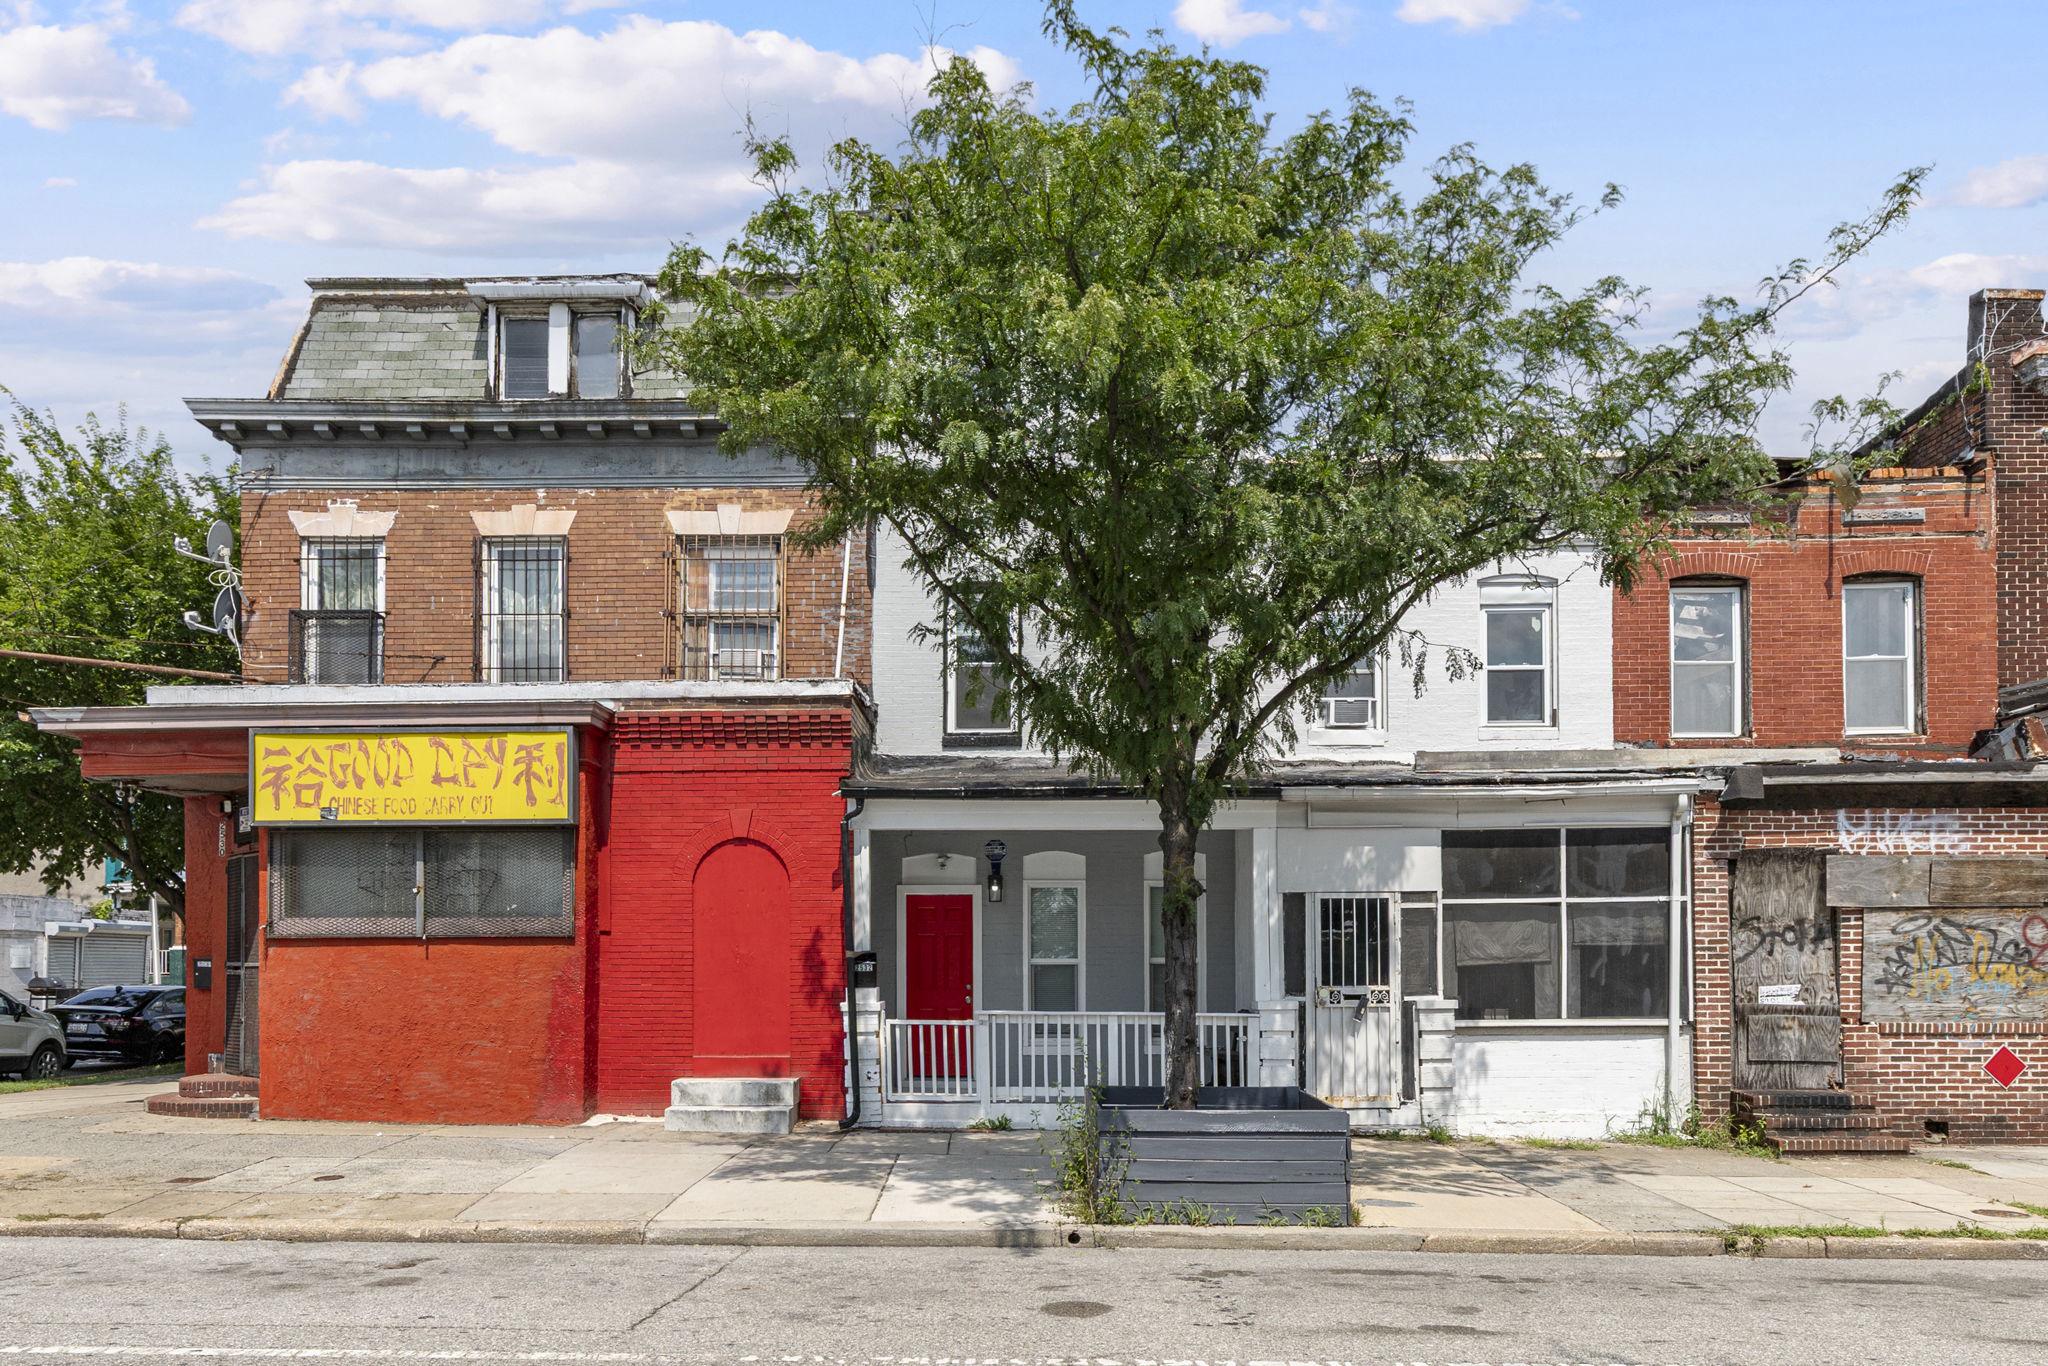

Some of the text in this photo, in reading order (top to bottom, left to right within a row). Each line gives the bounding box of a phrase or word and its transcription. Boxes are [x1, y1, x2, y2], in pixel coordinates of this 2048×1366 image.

[325, 735, 508, 790] GOOD DAY
[512, 742, 565, 807] 利
[329, 796, 378, 815] CHINESE
[383, 797, 417, 815] FOOD
